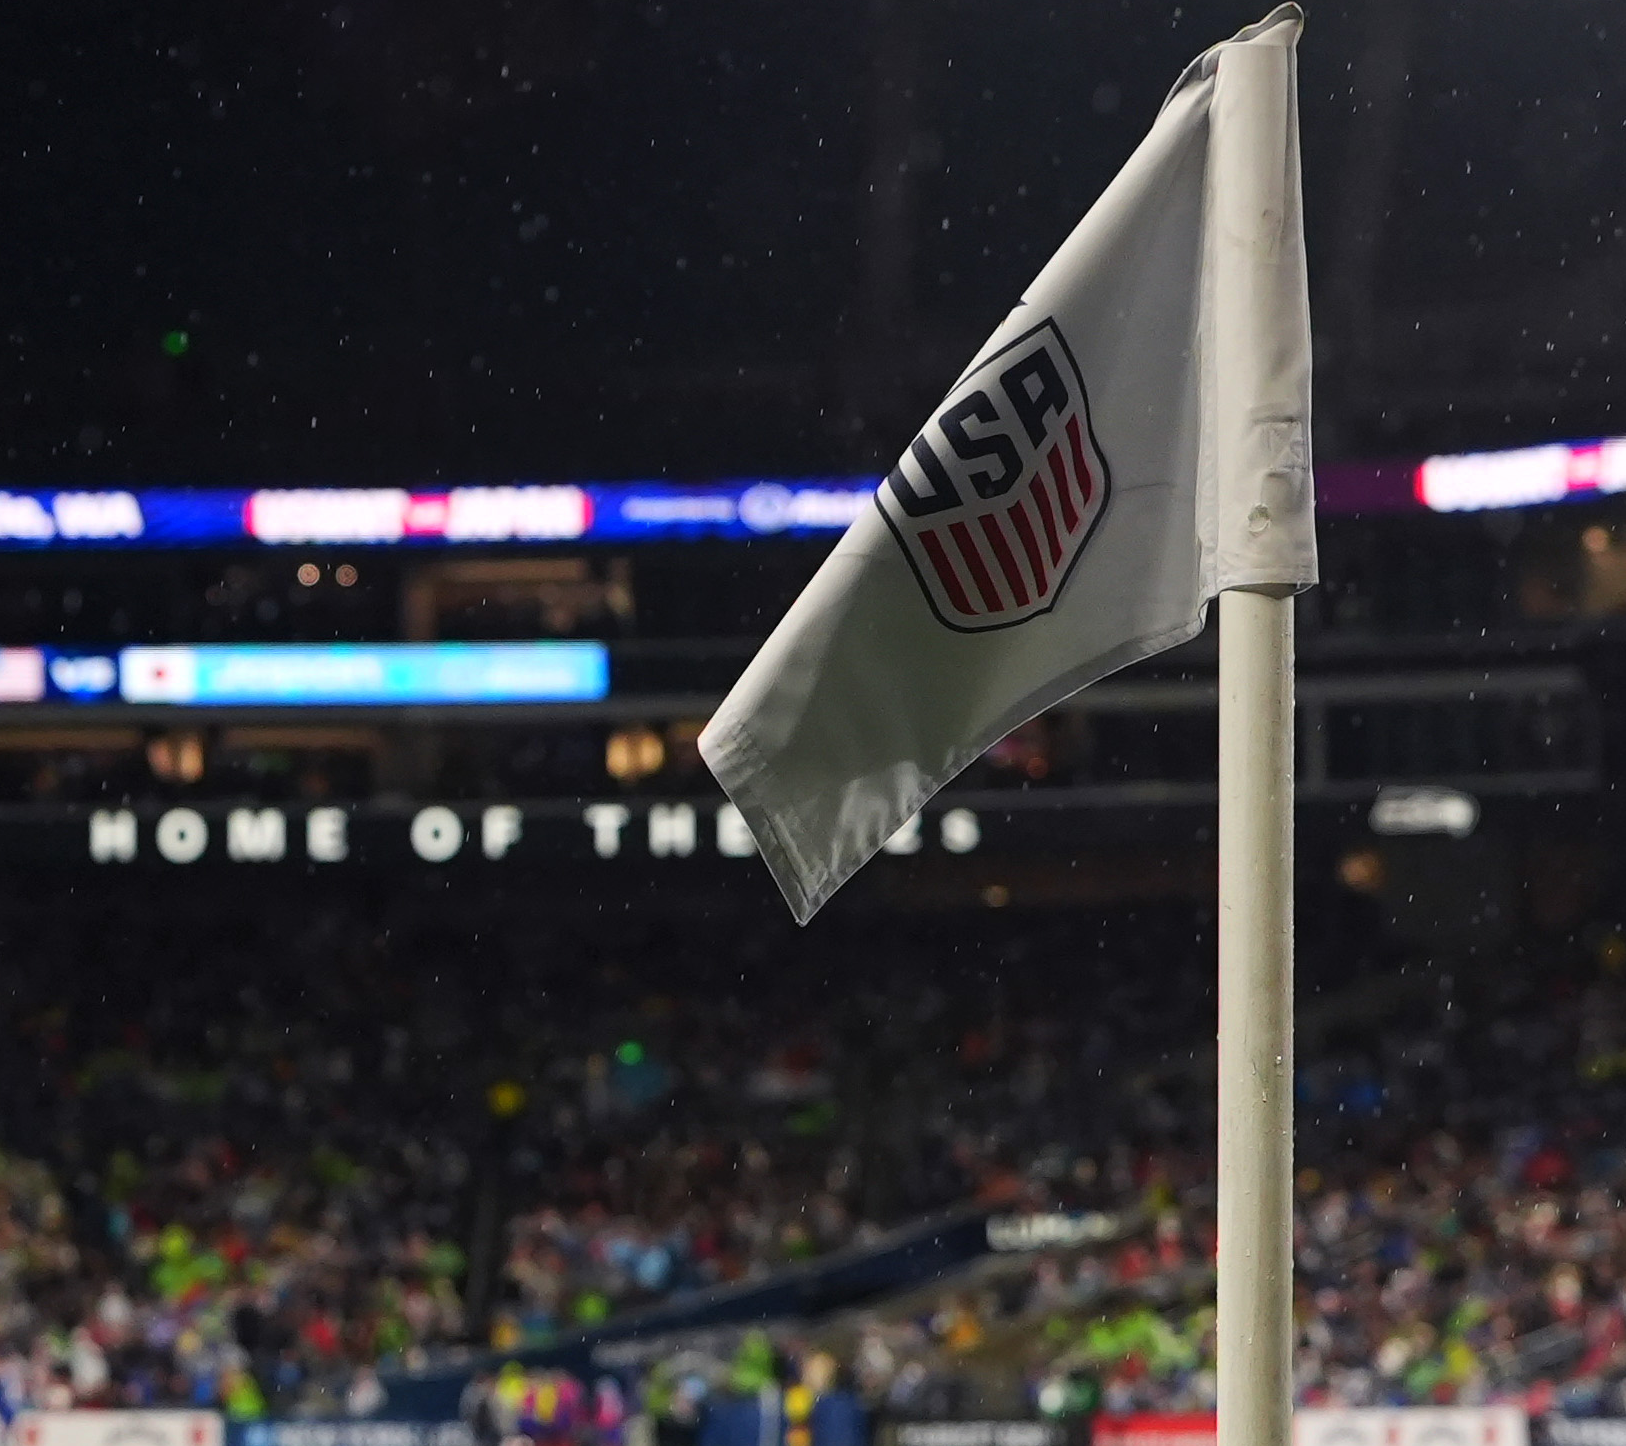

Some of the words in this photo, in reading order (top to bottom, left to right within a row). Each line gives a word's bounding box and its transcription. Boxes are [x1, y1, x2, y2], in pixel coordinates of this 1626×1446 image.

[887, 347, 1069, 518] USA
[89, 807, 348, 865] HOME
[410, 804, 523, 863] OF
[582, 802, 756, 858] THE
